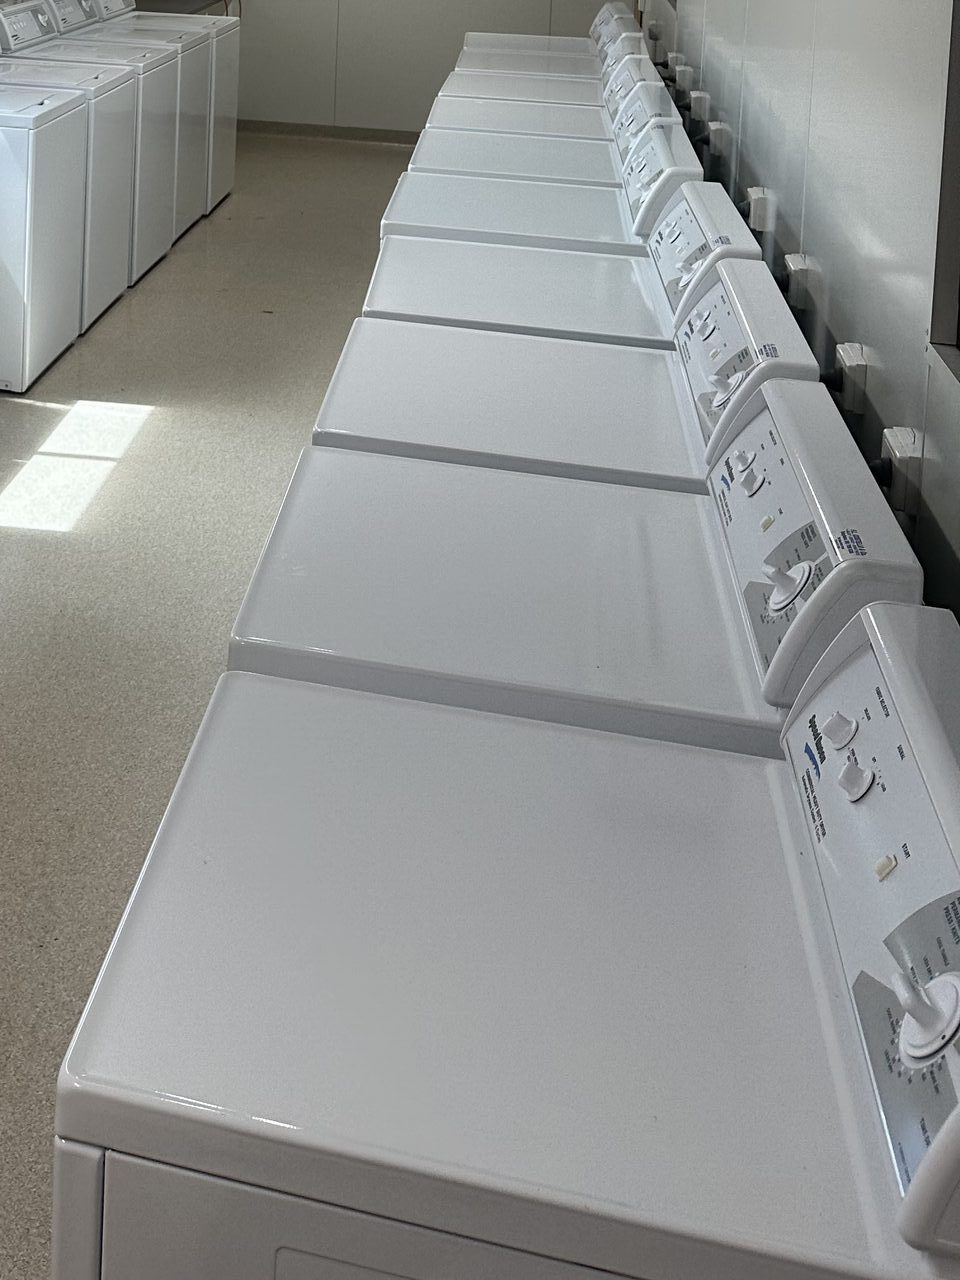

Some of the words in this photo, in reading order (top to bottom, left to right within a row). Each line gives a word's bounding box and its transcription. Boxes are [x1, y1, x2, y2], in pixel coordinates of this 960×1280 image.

[808, 714, 821, 741] Speed
[815, 734, 826, 765] Queen
[902, 843, 911, 859] START
